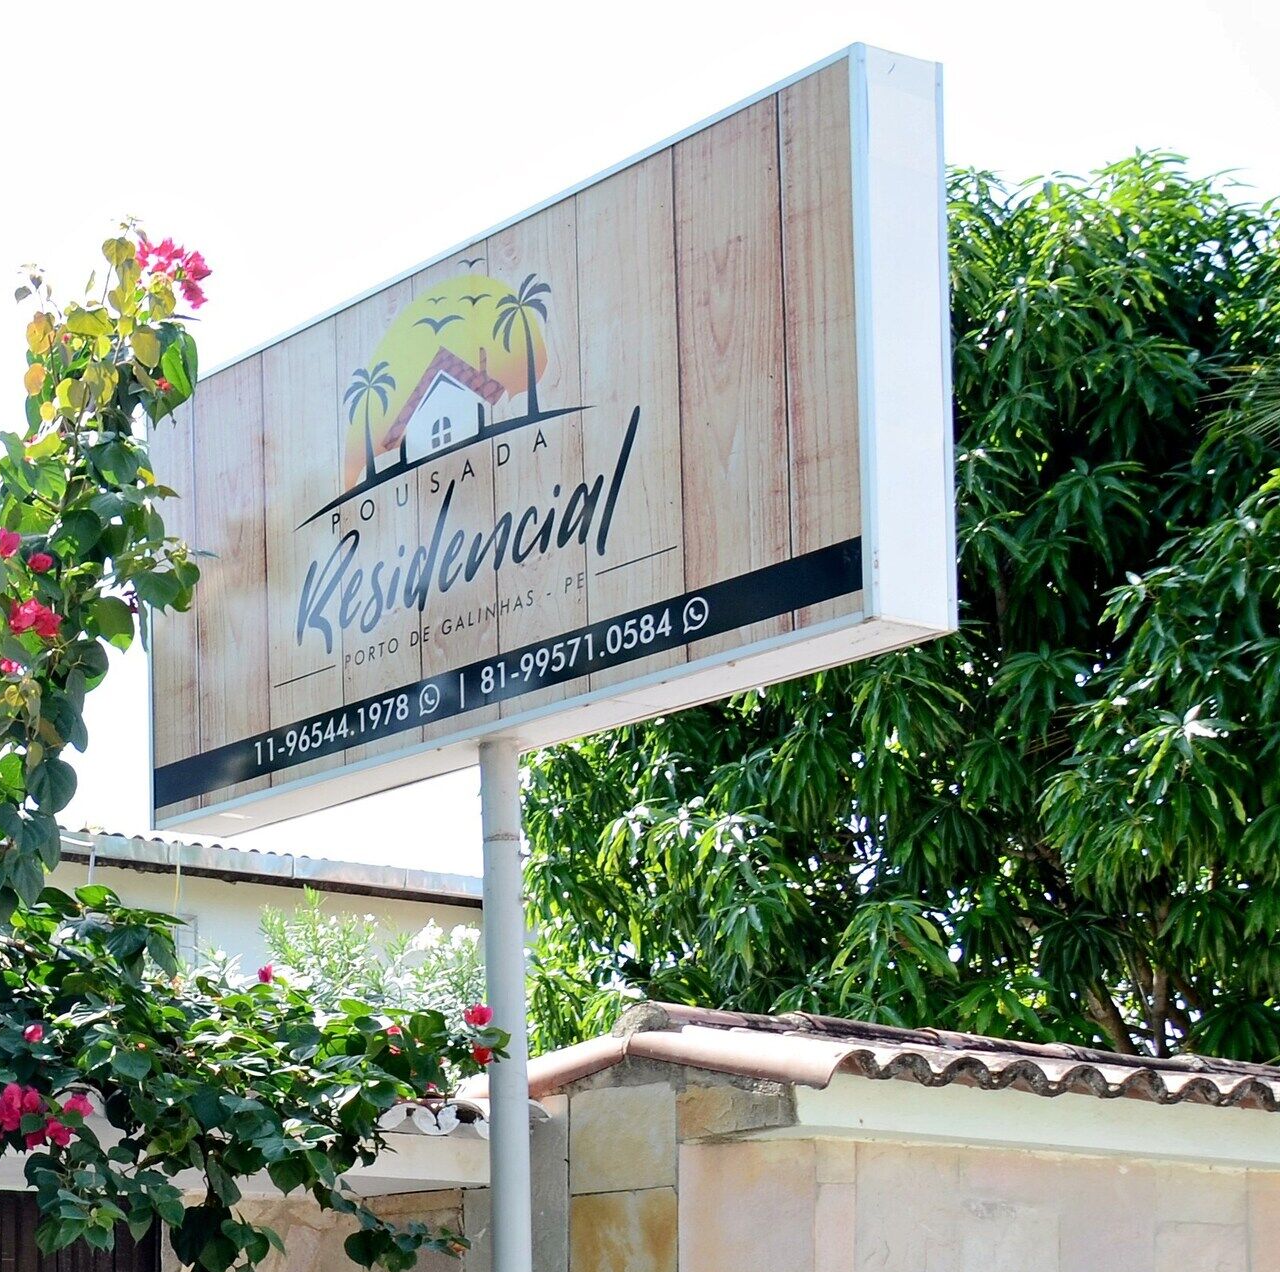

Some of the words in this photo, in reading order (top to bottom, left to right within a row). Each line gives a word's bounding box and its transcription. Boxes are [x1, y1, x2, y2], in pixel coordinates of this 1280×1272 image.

[296, 405, 640, 655] Residencial
[331, 428, 548, 534] POUSADA
[254, 693, 409, 765] 11-96544.1978
[480, 607, 672, 694] 81-99571.0584
[344, 637, 399, 669] PORTO
[410, 626, 430, 647] DE
[441, 589, 534, 636] GALINHAS
[564, 572, 585, 594] PE
